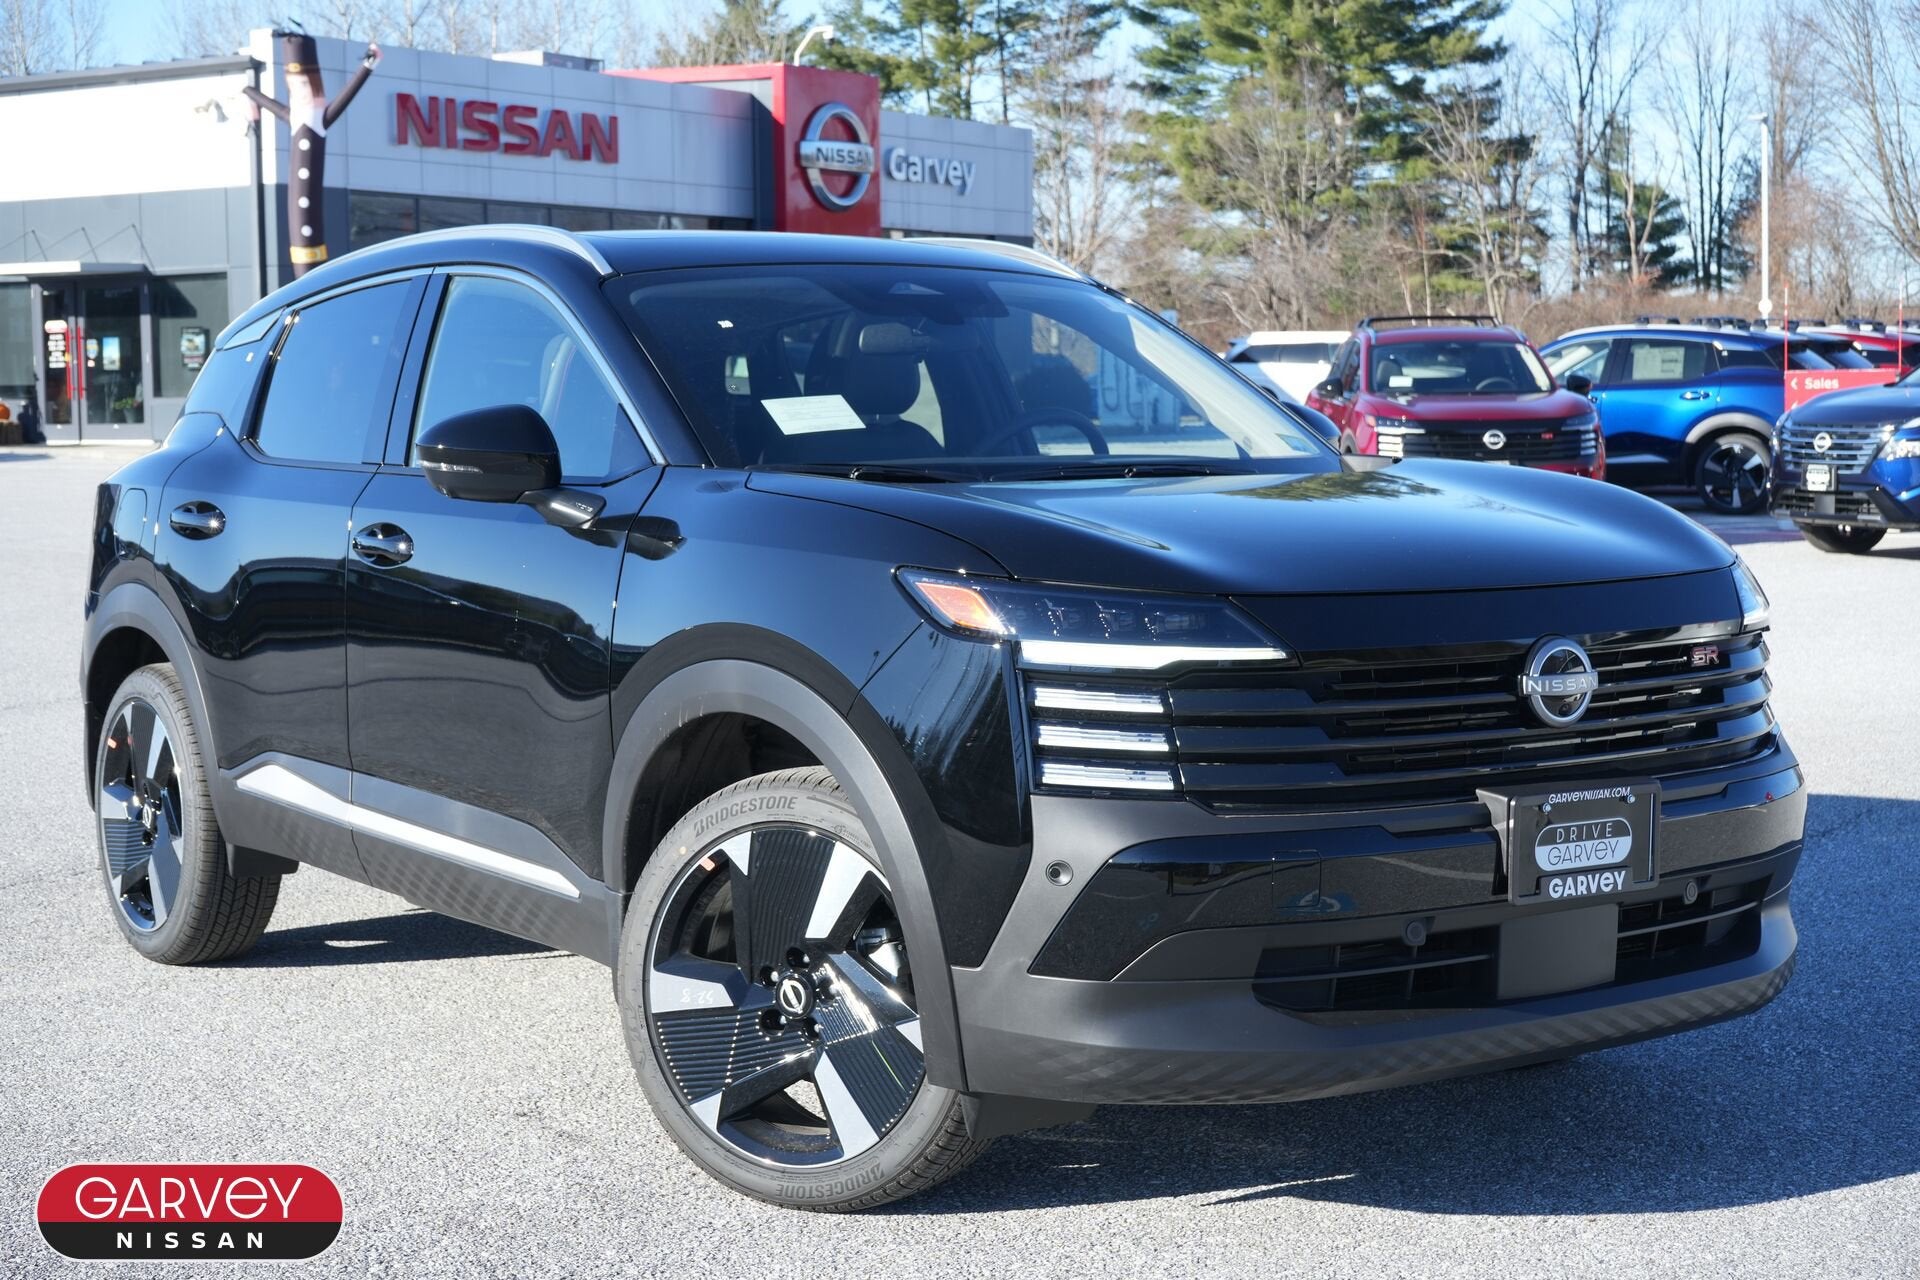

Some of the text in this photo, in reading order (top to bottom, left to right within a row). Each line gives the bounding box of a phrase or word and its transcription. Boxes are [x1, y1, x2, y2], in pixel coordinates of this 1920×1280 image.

[395, 92, 618, 164] NISSAN
[887, 147, 977, 196] Garvey
[1804, 377, 1839, 390] Sales
[1691, 647, 1720, 667] SR
[1527, 677, 1597, 693] NISSAN
[694, 796, 798, 839] BRIDGESTONE
[1556, 822, 1613, 843] DRIVE
[775, 1162, 885, 1199] BRIDGESTONE
